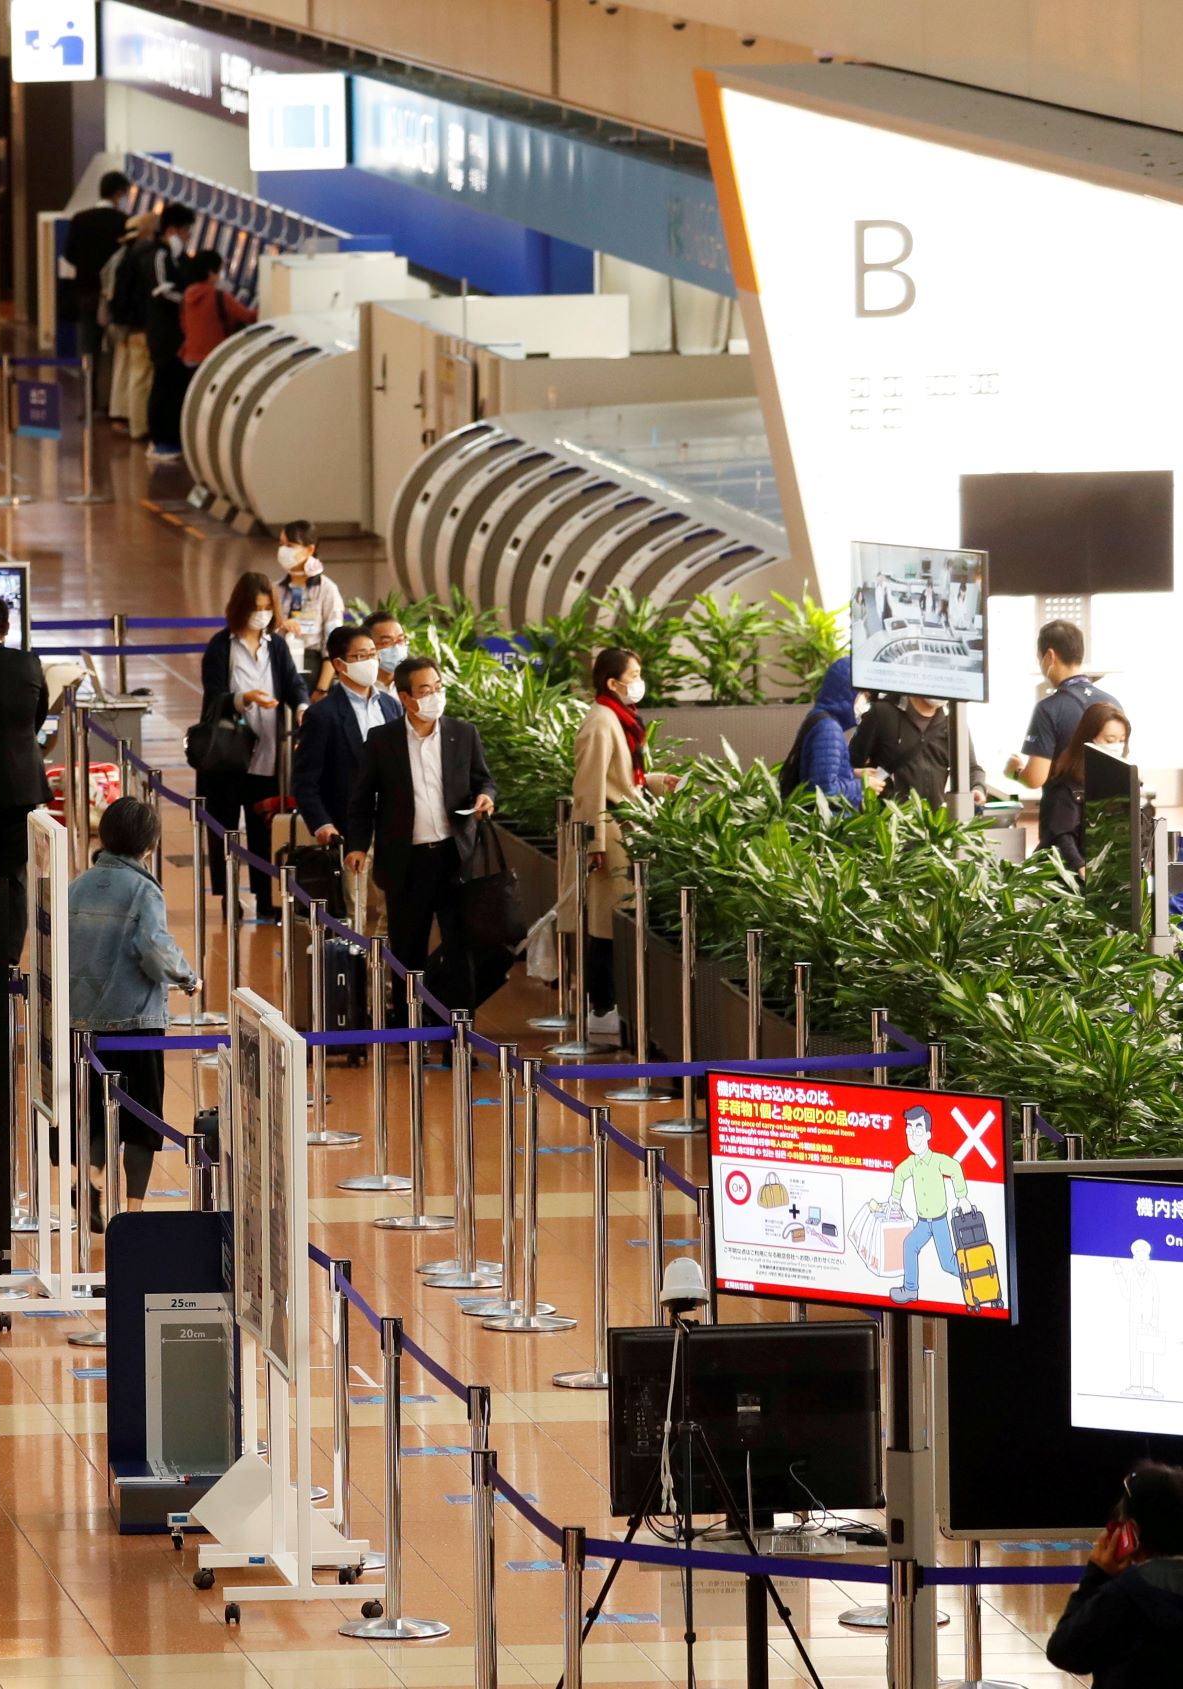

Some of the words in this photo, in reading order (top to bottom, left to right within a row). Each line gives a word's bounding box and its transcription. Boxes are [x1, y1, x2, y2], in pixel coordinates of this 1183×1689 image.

[853, 219, 917, 319] B
[717, 1080, 834, 1106] 機内に持ち込めるのは、
[718, 1099, 893, 1130] 手荷物1個と身の回りの品のみです
[718, 1118, 730, 1126] Only
[741, 1120, 755, 1128] piece
[762, 1122, 783, 1131] carry-on
[784, 1123, 806, 1133] baggage
[818, 1128, 840, 1136] personal
[736, 1127, 756, 1137] brought
[780, 1131, 800, 1140] aircraft.
[731, 1182, 744, 1193] OK
[171, 1298, 197, 1308] 25cm
[179, 1329, 206, 1339] 20cm
